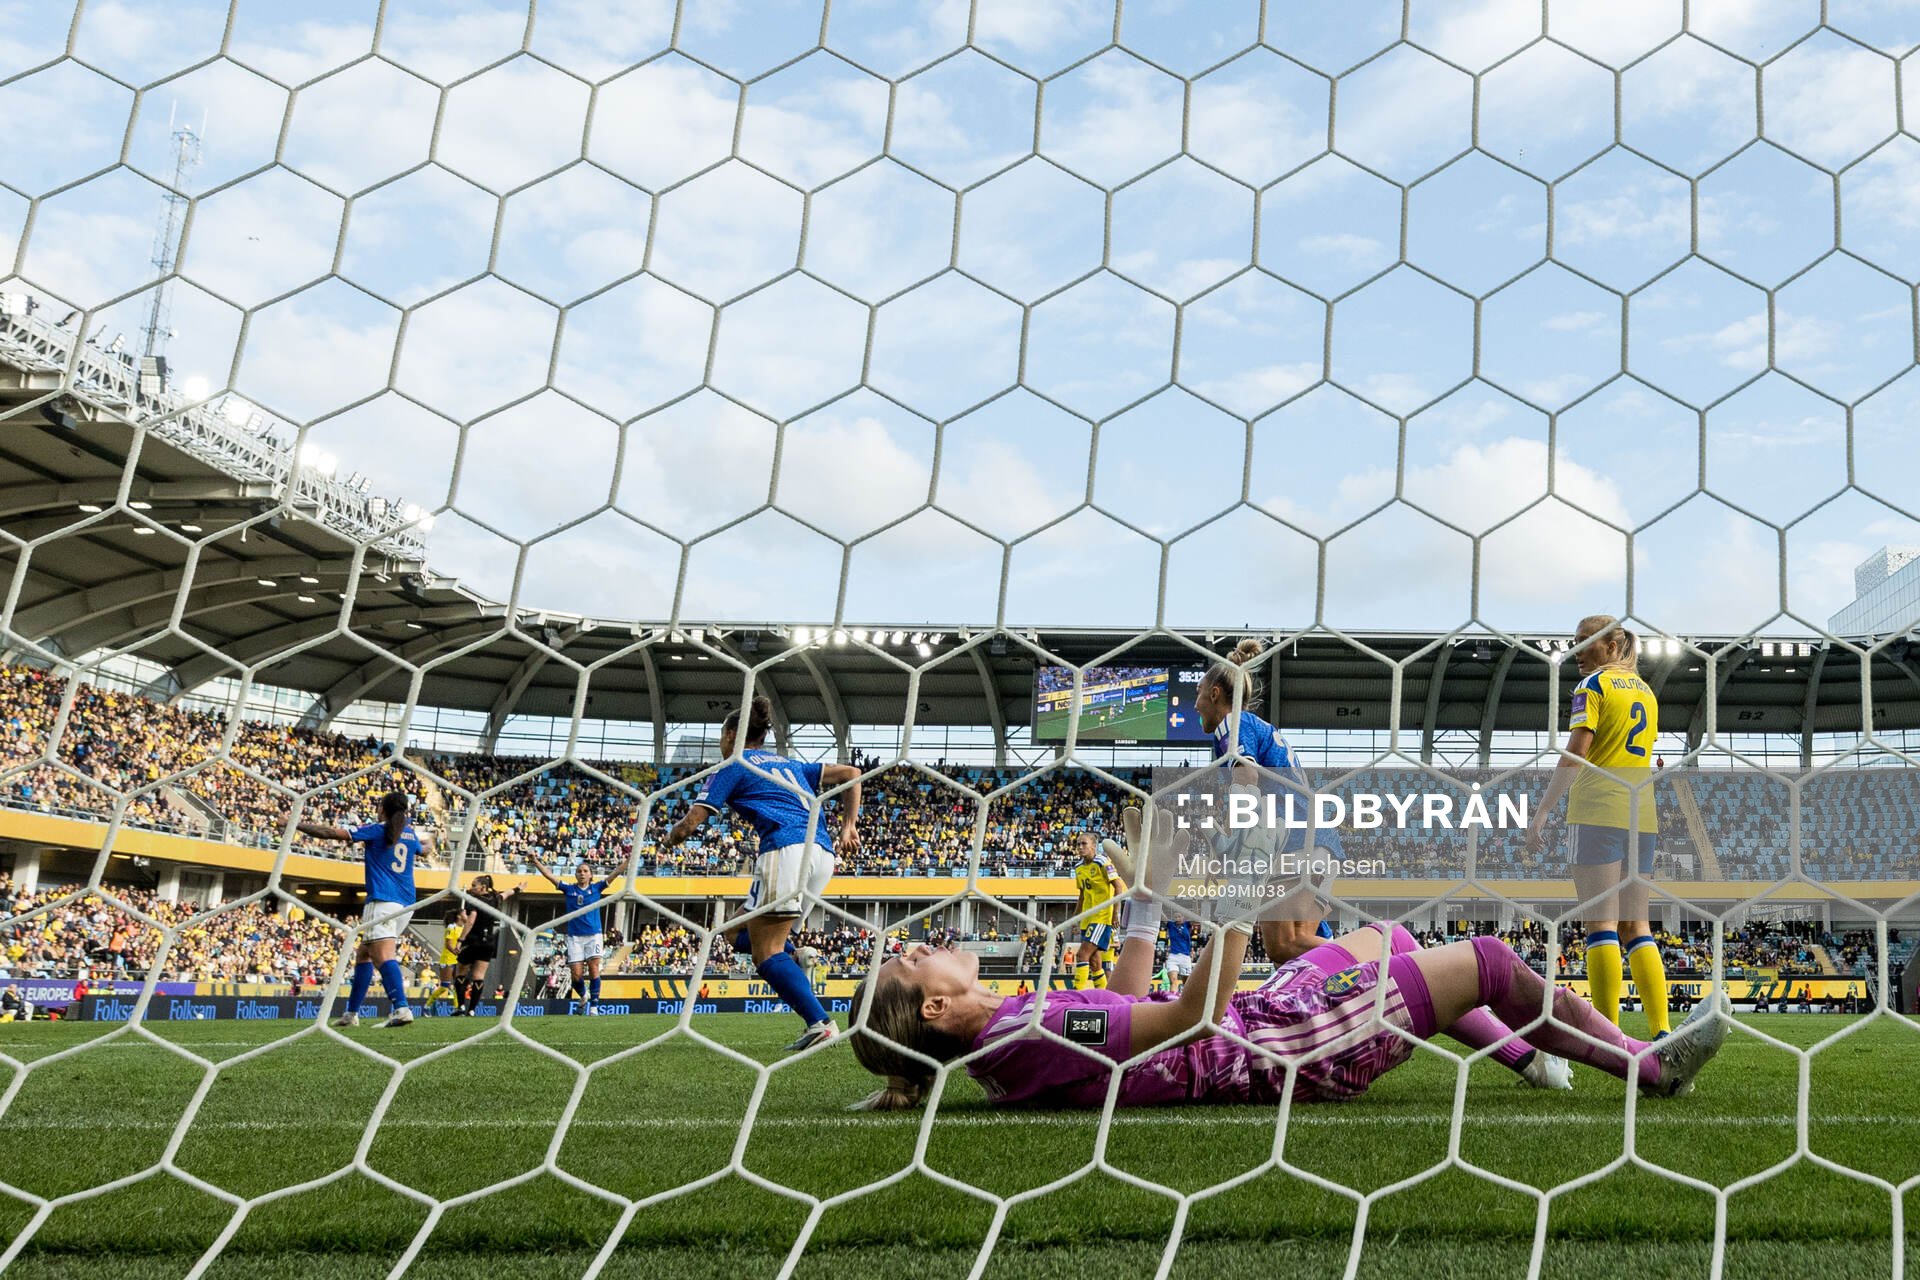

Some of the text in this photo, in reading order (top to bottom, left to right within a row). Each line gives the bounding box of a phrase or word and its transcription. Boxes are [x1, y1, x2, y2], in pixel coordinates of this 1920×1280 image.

[1336, 707, 1361, 717] B4
[1625, 702, 1647, 757] 2
[391, 843, 409, 873] 9
[1234, 899, 1253, 911] Falk
[169, 1000, 216, 1020] Folksam
[236, 1000, 280, 1019] Folksam
